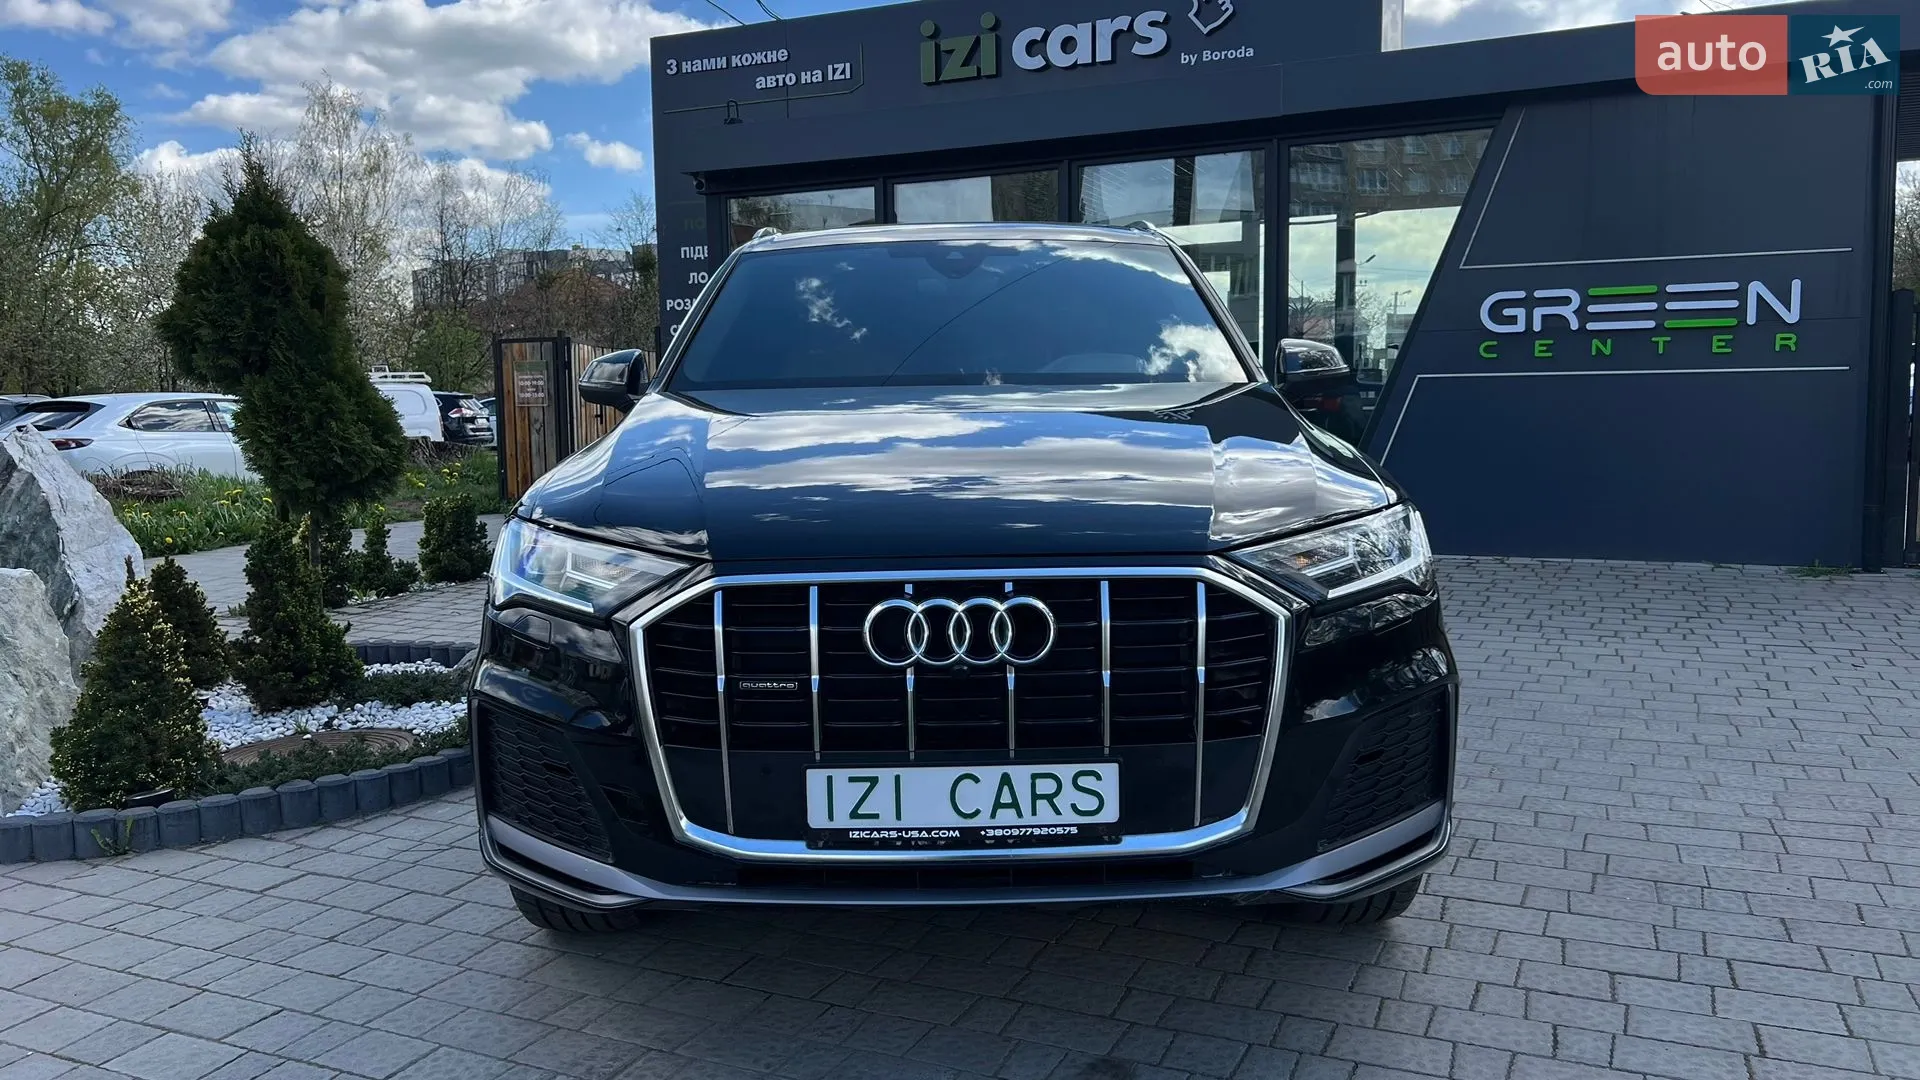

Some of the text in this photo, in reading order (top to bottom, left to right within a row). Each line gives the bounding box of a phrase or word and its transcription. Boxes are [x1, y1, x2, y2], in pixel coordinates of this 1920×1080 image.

[920, 10, 1169, 84] izi cars
[1180, 46, 1254, 66] by Boroda
[681, 56, 727, 73] нами
[731, 48, 789, 67] кожне
[755, 62, 851, 89] авто на IZI
[1479, 278, 1802, 333] GREEN
[1478, 333, 1797, 358] CENTER
[826, 769, 1105, 822] IZI CARS
[849, 826, 1078, 839] IZICARS-USA.COM +380977920575
